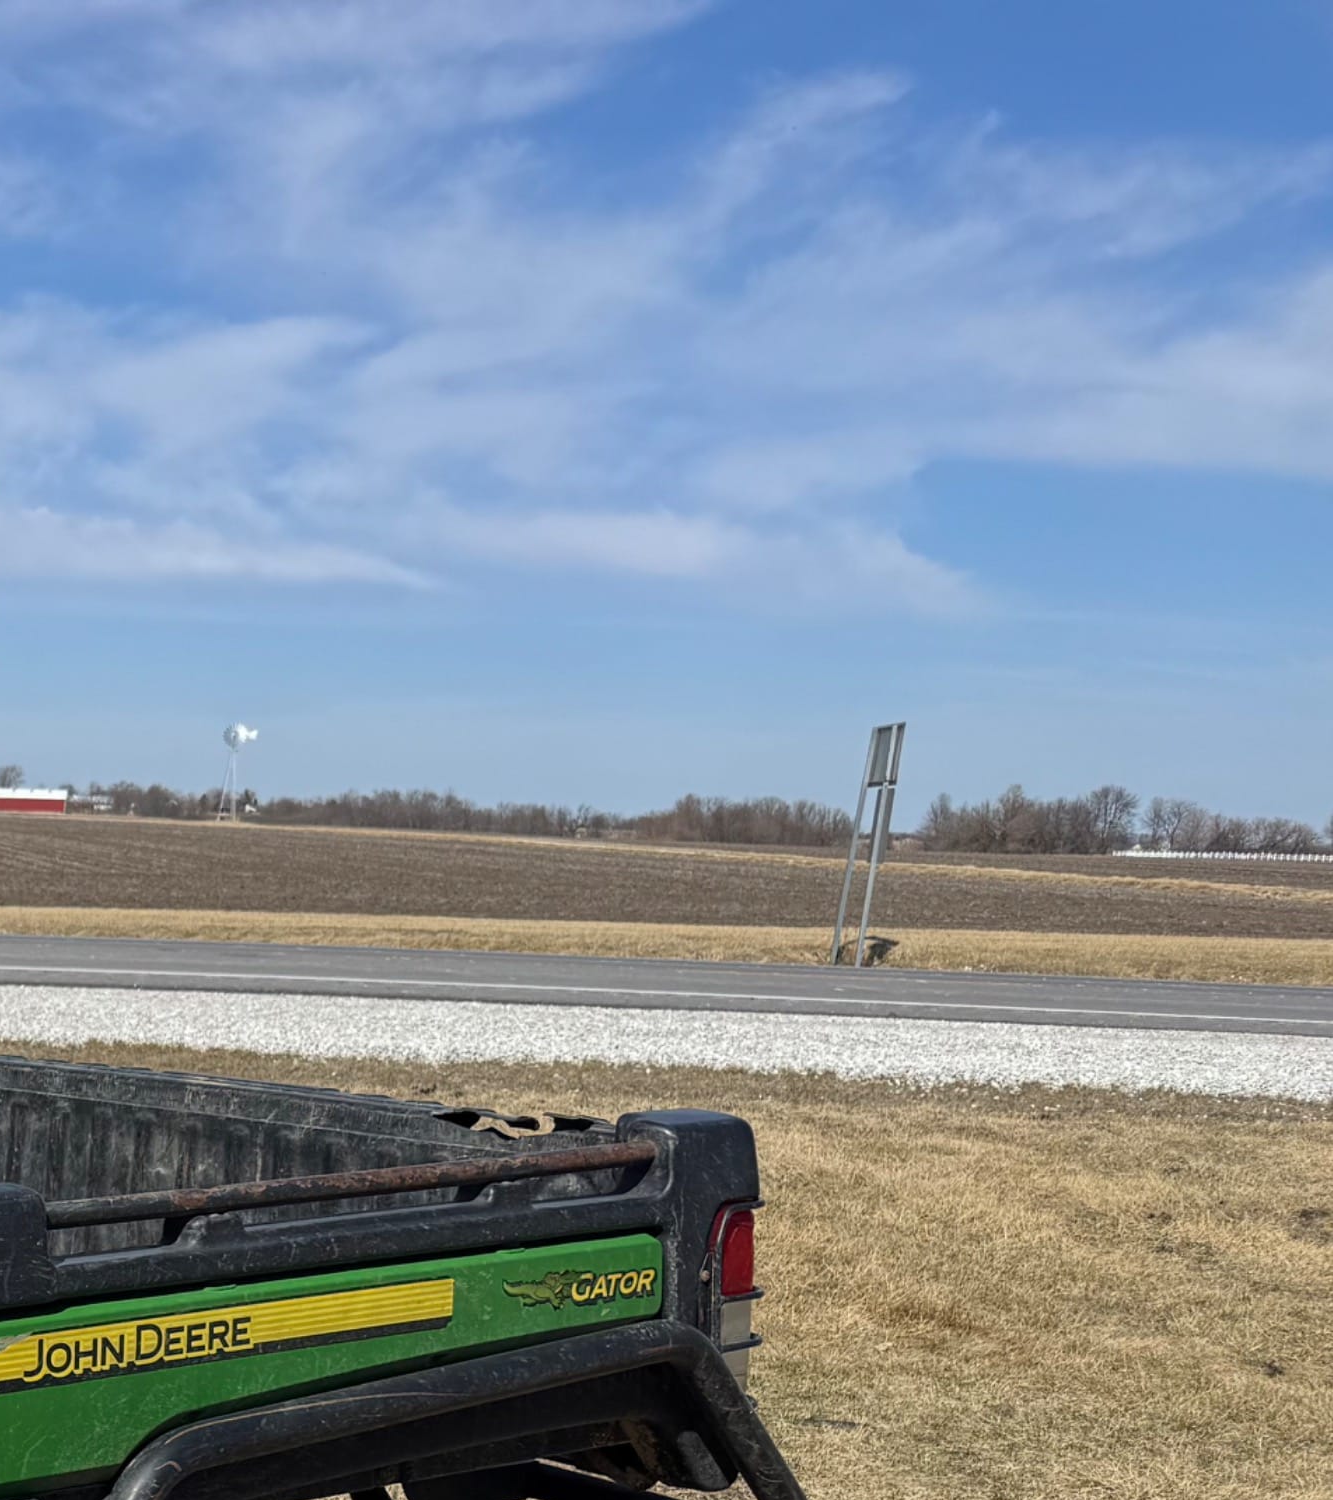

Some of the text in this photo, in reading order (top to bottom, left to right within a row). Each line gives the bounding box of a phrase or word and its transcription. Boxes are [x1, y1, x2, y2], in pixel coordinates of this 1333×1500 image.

[571, 1268, 656, 1303] GATOR
[23, 1317, 252, 1379] JOHN DEERE
